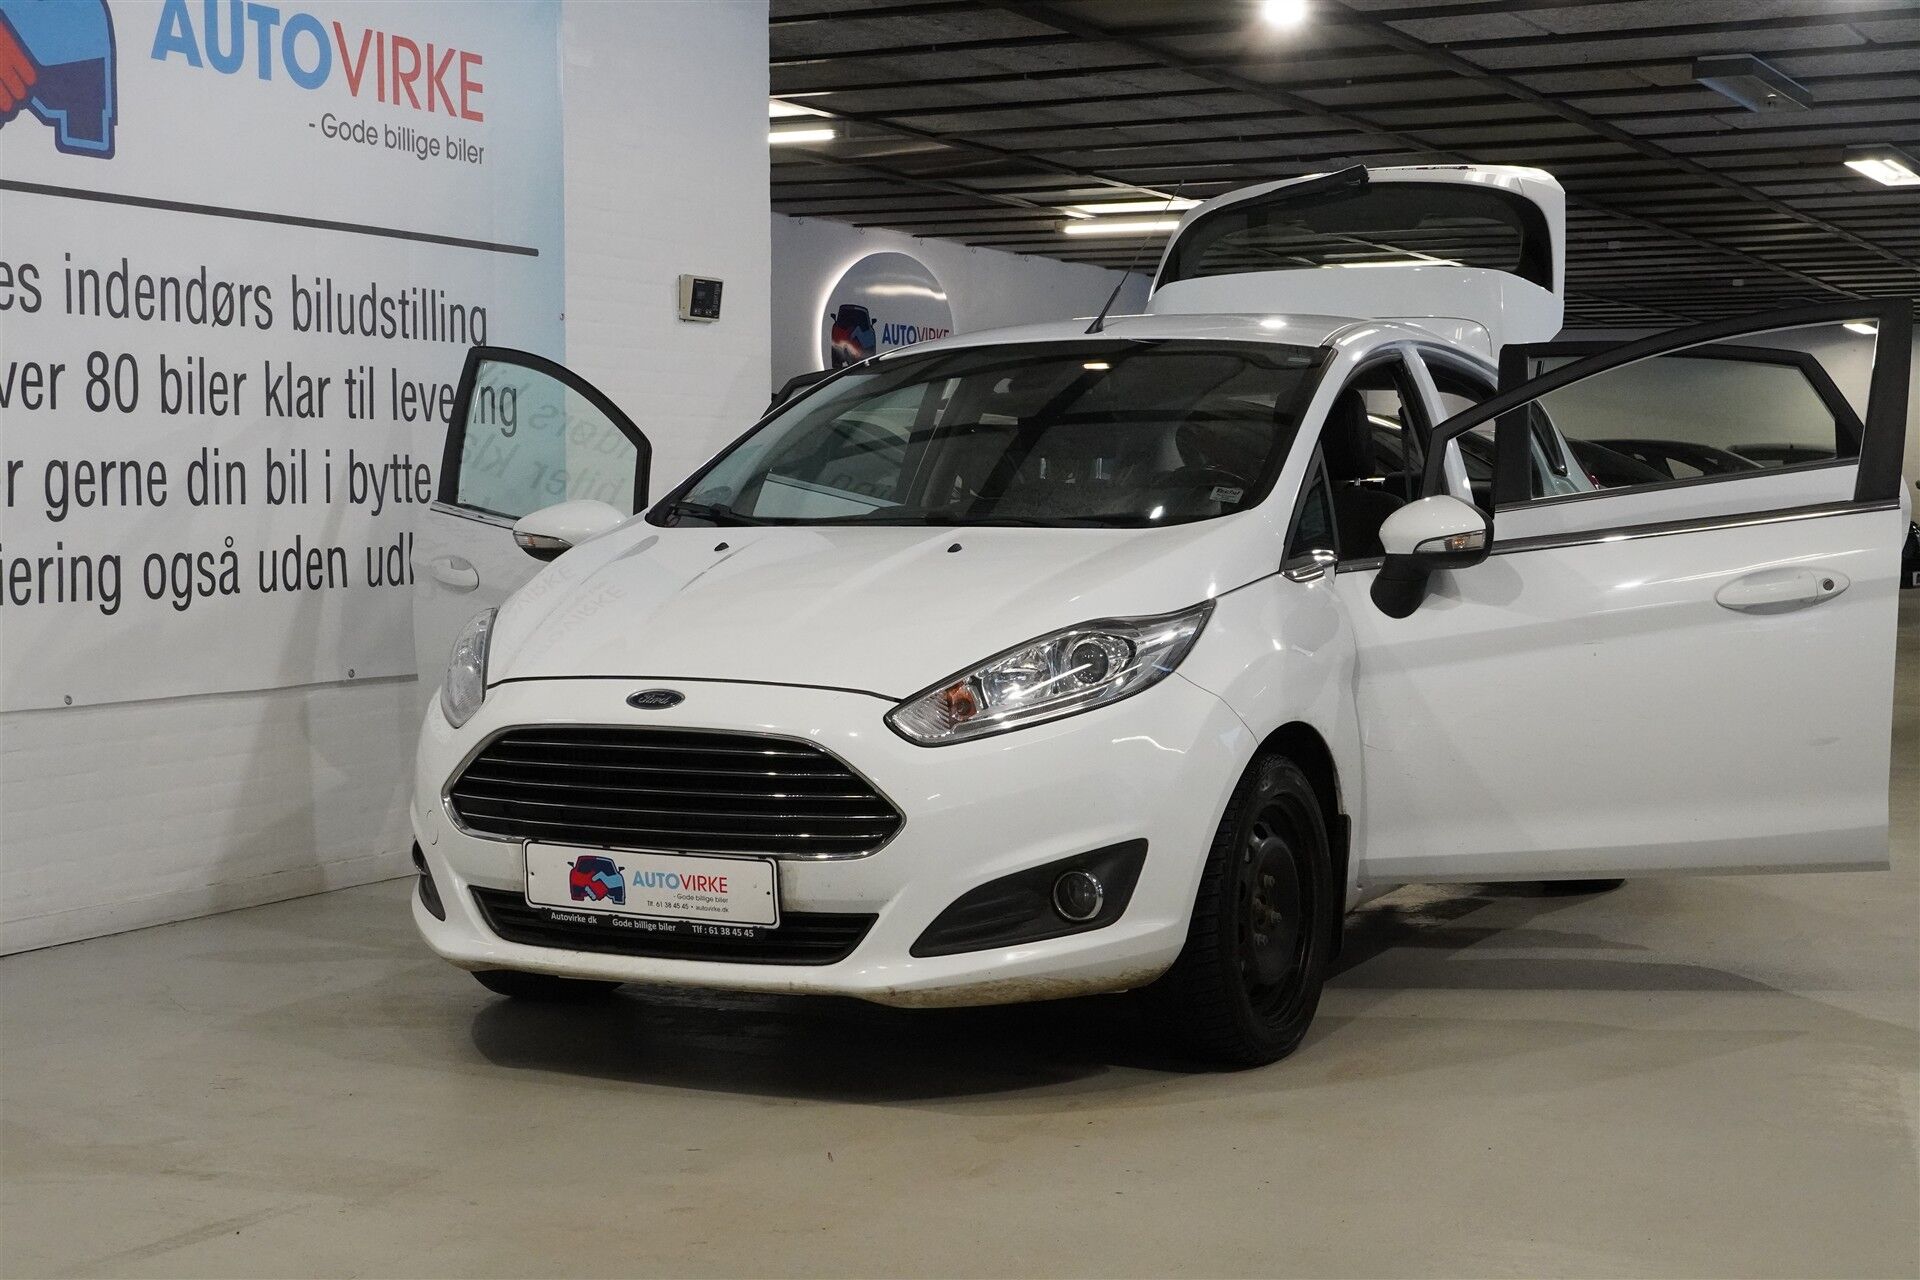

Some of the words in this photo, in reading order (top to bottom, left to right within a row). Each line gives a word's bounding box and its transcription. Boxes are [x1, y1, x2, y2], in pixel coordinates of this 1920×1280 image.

[151, 0, 484, 123] AUTOVIRKE
[321, 112, 379, 146] Gode
[384, 123, 441, 161] billige
[446, 135, 485, 165] biler
[65, 252, 274, 331] indendørs
[291, 273, 488, 347] biludstilling
[85, 350, 139, 413] 80
[160, 353, 247, 416] biler
[264, 359, 331, 419] klar
[344, 365, 375, 420] til
[391, 367, 518, 438] leveng
[44, 459, 168, 523] gerne
[187, 446, 247, 507] din
[266, 447, 307, 506] bil
[325, 448, 332, 504] i
[349, 448, 432, 517] bytte
[143, 535, 241, 612] også
[259, 534, 349, 594] uden
[632, 870, 728, 894] AUTOVIRKE
[664, 901, 672, 909] 38
[673, 902, 681, 910] 45
[676, 893, 695, 902] Gode
[550, 911, 586, 923] Autovirke
[612, 918, 633, 928] Gode
[634, 920, 657, 932] billige
[658, 922, 676, 932] biler
[708, 926, 719, 935] 61
[720, 927, 731, 936] 38
[731, 928, 742, 937] 45
[743, 929, 754, 938] 45
